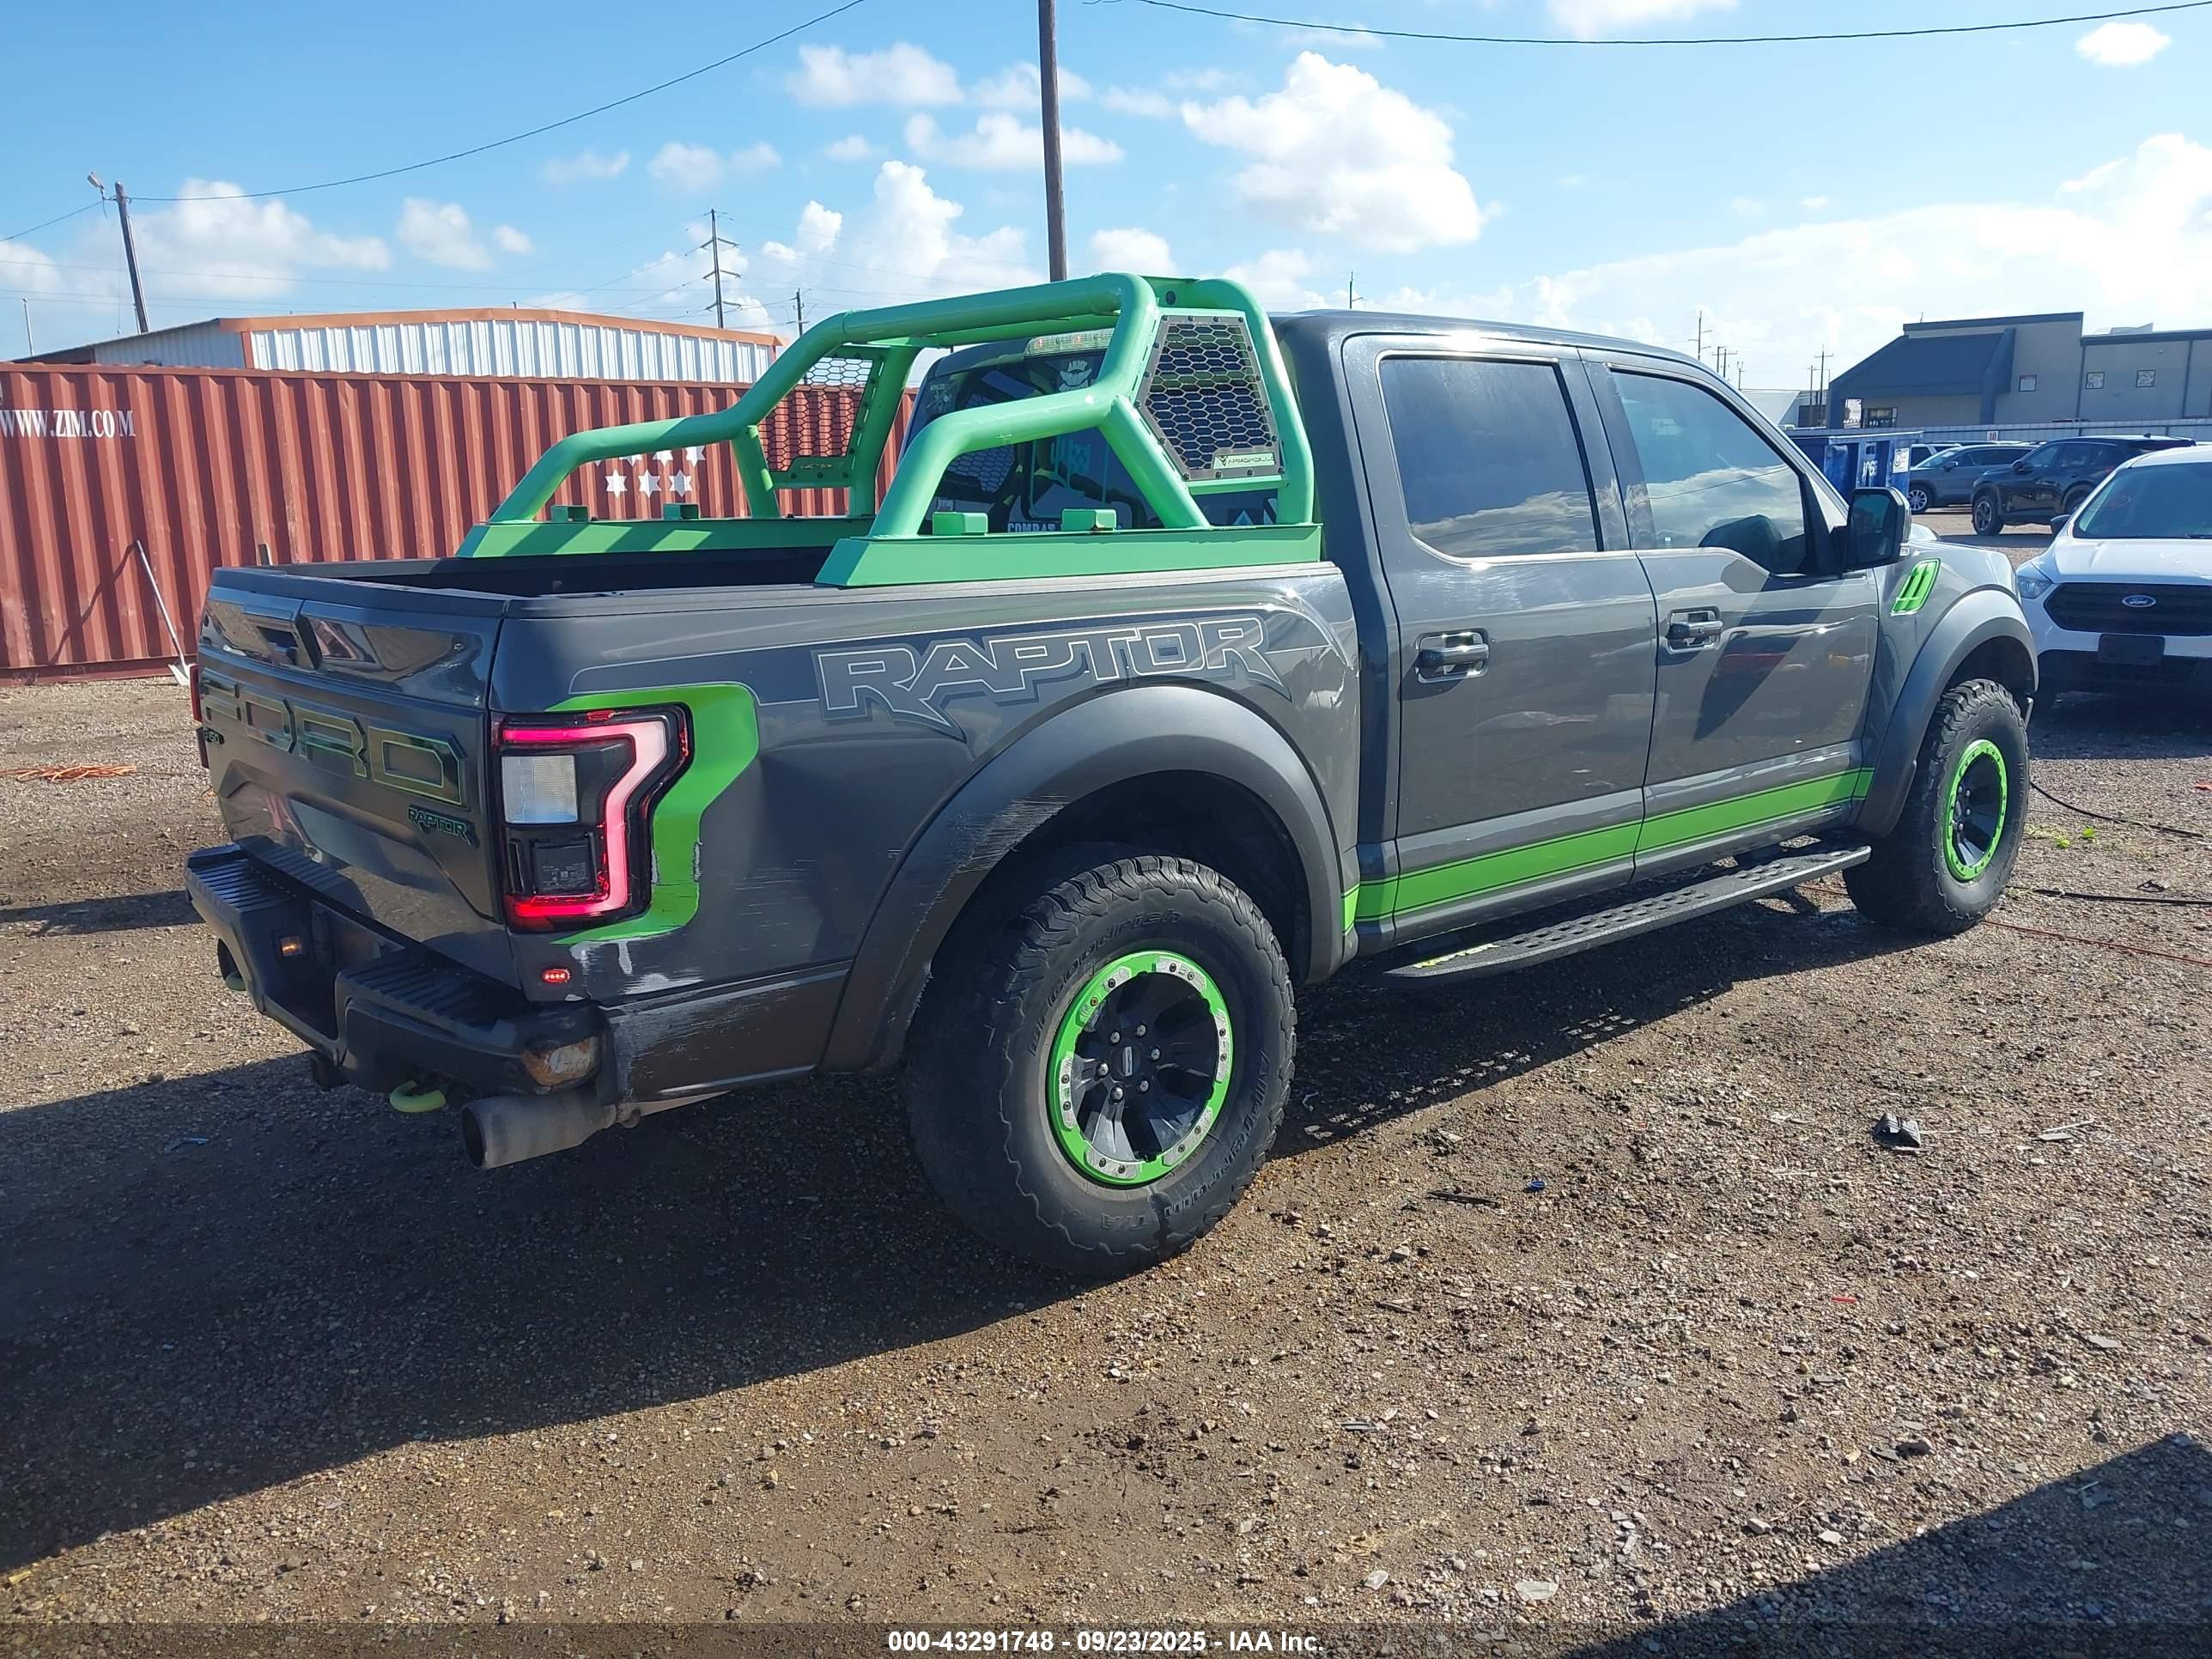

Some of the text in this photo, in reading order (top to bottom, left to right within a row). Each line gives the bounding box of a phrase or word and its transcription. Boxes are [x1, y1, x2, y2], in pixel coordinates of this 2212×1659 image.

[0, 410, 137, 438] WWW.ZIM.COM
[814, 616, 1291, 736] RAPTOR
[203, 667, 466, 806] FORD
[407, 806, 471, 846] RAPTOR
